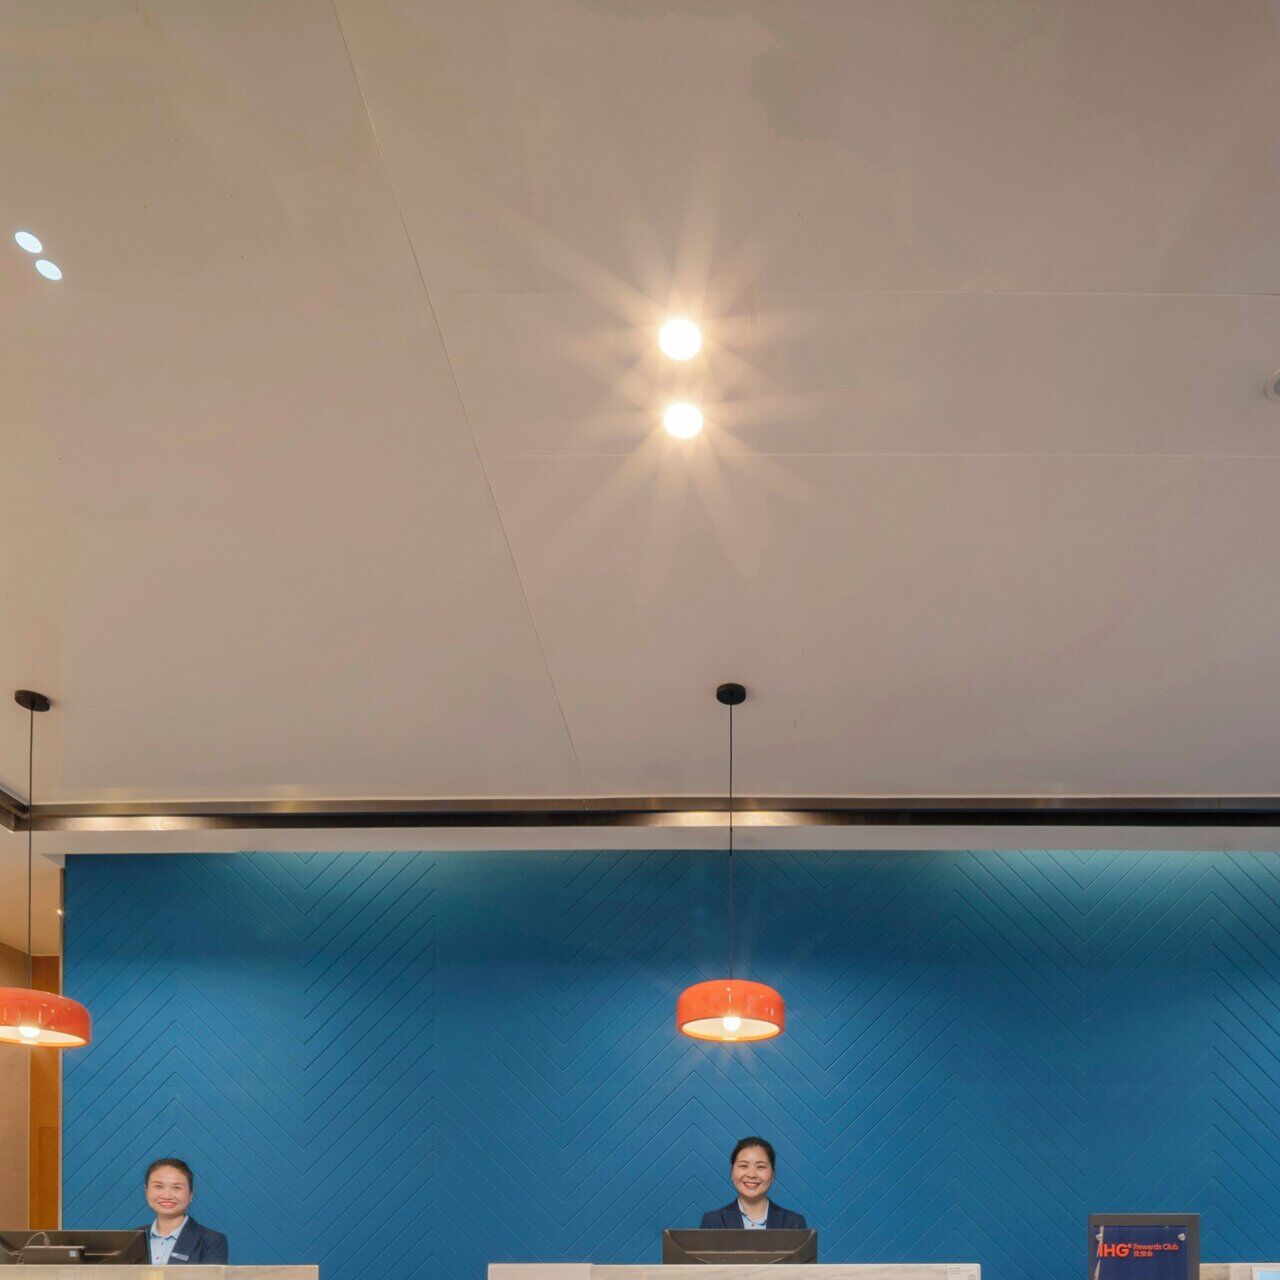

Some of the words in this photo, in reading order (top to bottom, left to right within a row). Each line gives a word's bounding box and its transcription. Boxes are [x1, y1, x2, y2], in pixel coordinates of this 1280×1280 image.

[1098, 1243, 1130, 1258] IHG
[1133, 1243, 1161, 1251] Rewards
[1163, 1243, 1179, 1251] Club
